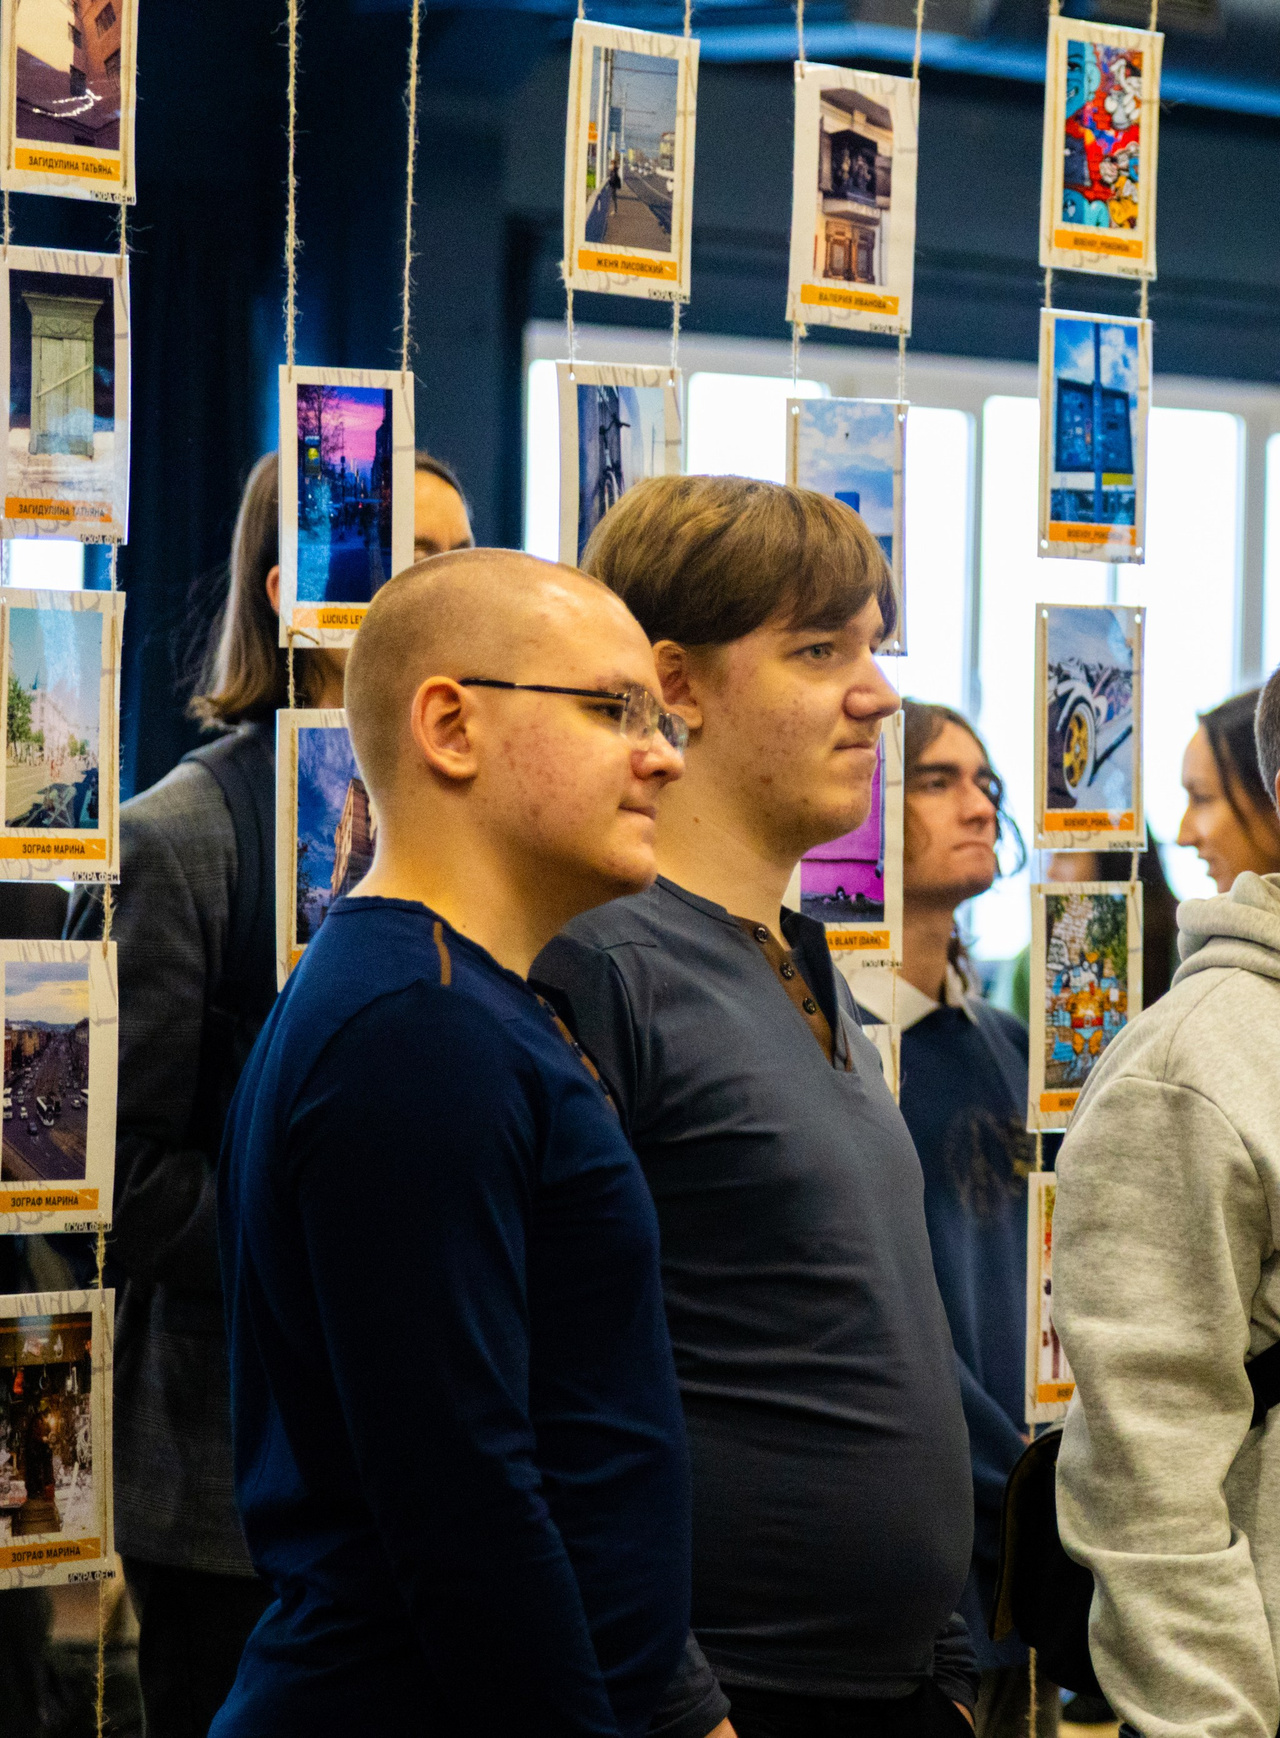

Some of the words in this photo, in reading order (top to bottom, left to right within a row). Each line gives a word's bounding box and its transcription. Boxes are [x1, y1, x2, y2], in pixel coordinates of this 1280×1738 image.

[28, 156, 79, 171] ЗАГИДУЛИНА
[81, 162, 113, 175] ТАТЬЯНА
[596, 257, 619, 268] ЖЕНЯ
[620, 260, 664, 274] ЛИСОВСКИЙ
[818, 291, 853, 303] ВАЛЕРИЯ
[18, 503, 70, 516] ЗАГИДУЛИНА
[71, 506, 105, 517] ТАТЬЯНА
[322, 614, 349, 624] LUCIUS
[22, 844, 52, 854] ЗОГРАФ
[53, 844, 86, 854] МАРИНА
[835, 936, 857, 945] BLANT
[10, 1196, 43, 1207] ЗОГРАФ
[44, 1195, 79, 1206] МАРИНА
[11, 1551, 44, 1562] ЗОГРАФ
[46, 1546, 81, 1559] МАРИНА
